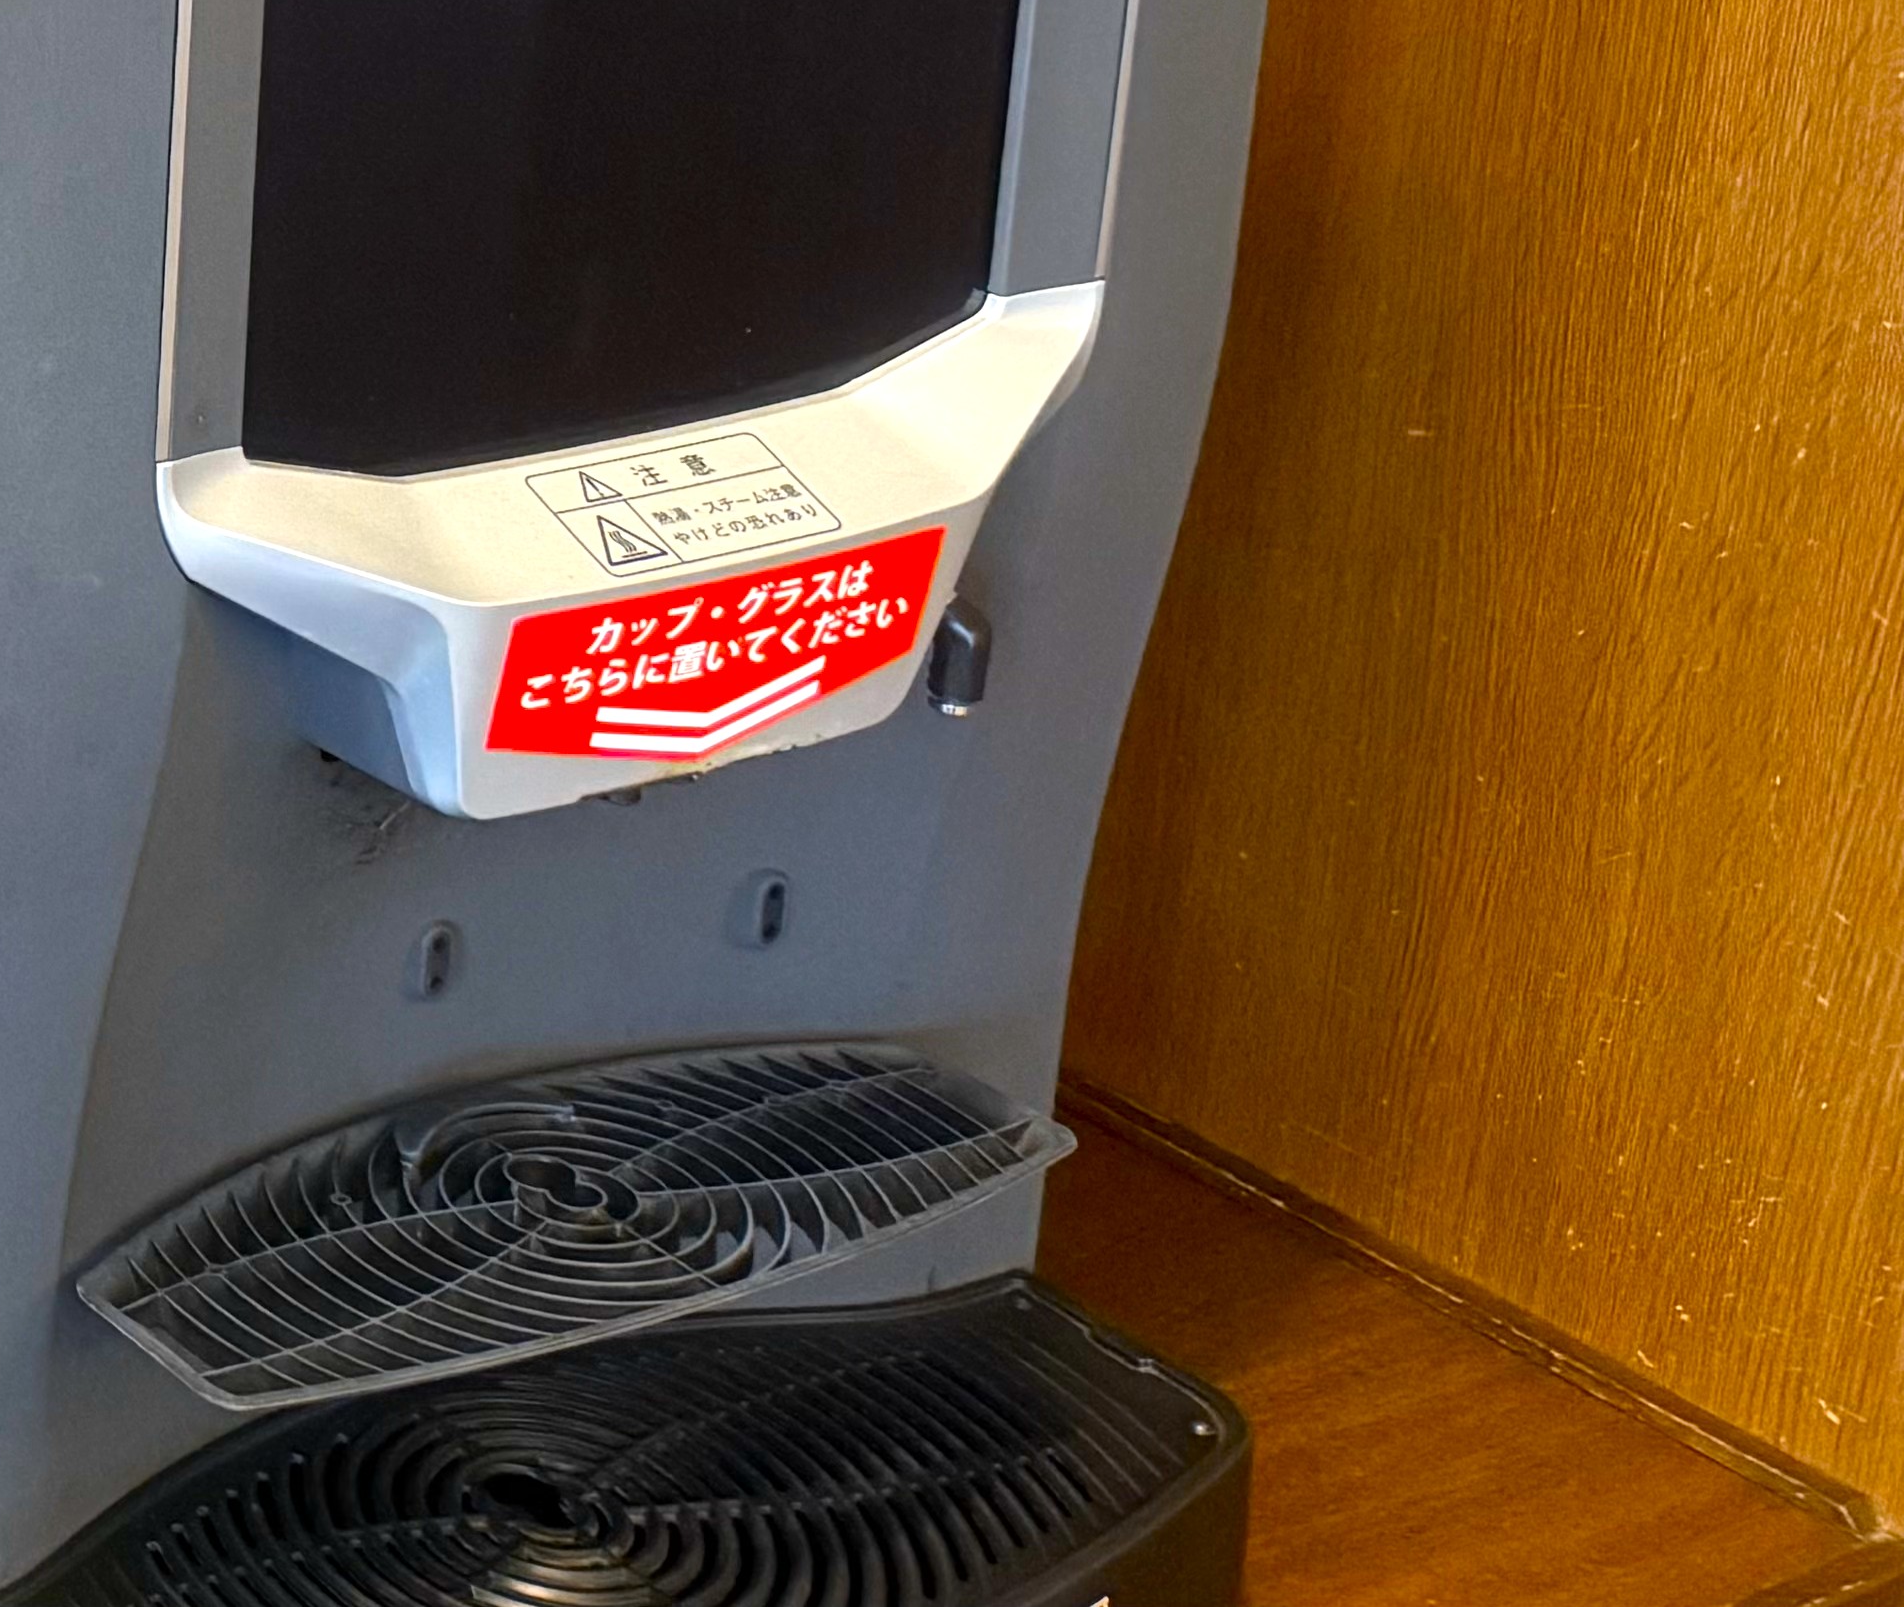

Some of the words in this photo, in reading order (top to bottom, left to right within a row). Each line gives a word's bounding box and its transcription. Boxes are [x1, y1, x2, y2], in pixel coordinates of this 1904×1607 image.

[673, 503, 818, 545] やけどの恐れあり
[520, 595, 910, 710] こちらに置いてください
[586, 559, 875, 658] カップ・グラスは
